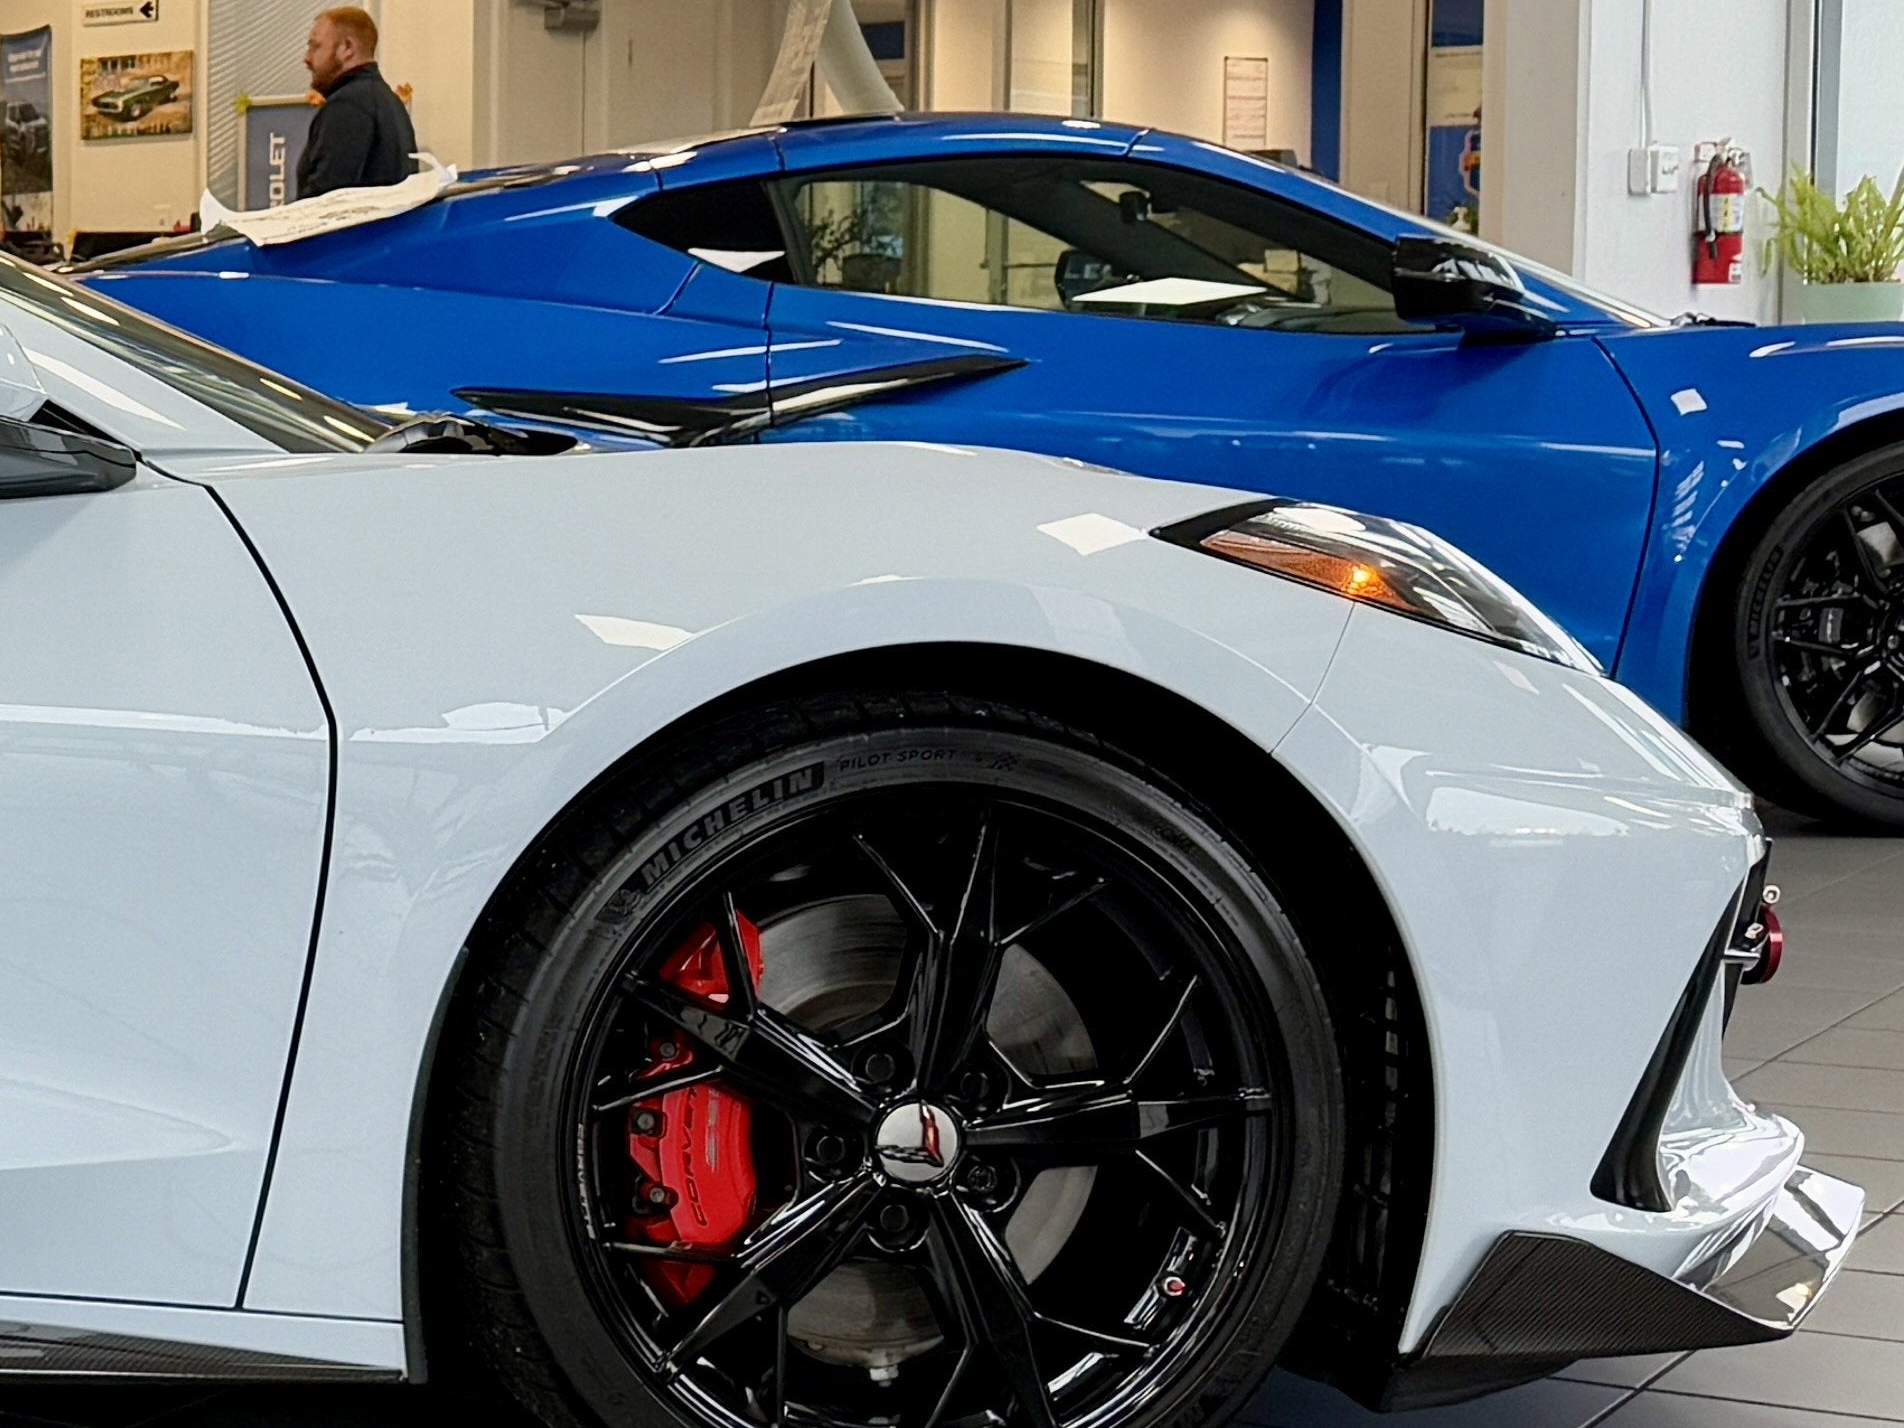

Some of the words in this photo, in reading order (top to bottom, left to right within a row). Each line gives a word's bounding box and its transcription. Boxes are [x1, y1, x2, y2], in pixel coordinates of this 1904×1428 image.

[85, 6, 134, 19] RESTROOMS
[269, 132, 285, 207] OLET
[838, 754, 890, 772] PILOT
[895, 749, 956, 763] SPORT
[641, 769, 815, 886] MICHELIN
[682, 1085, 708, 1227] CORVET
